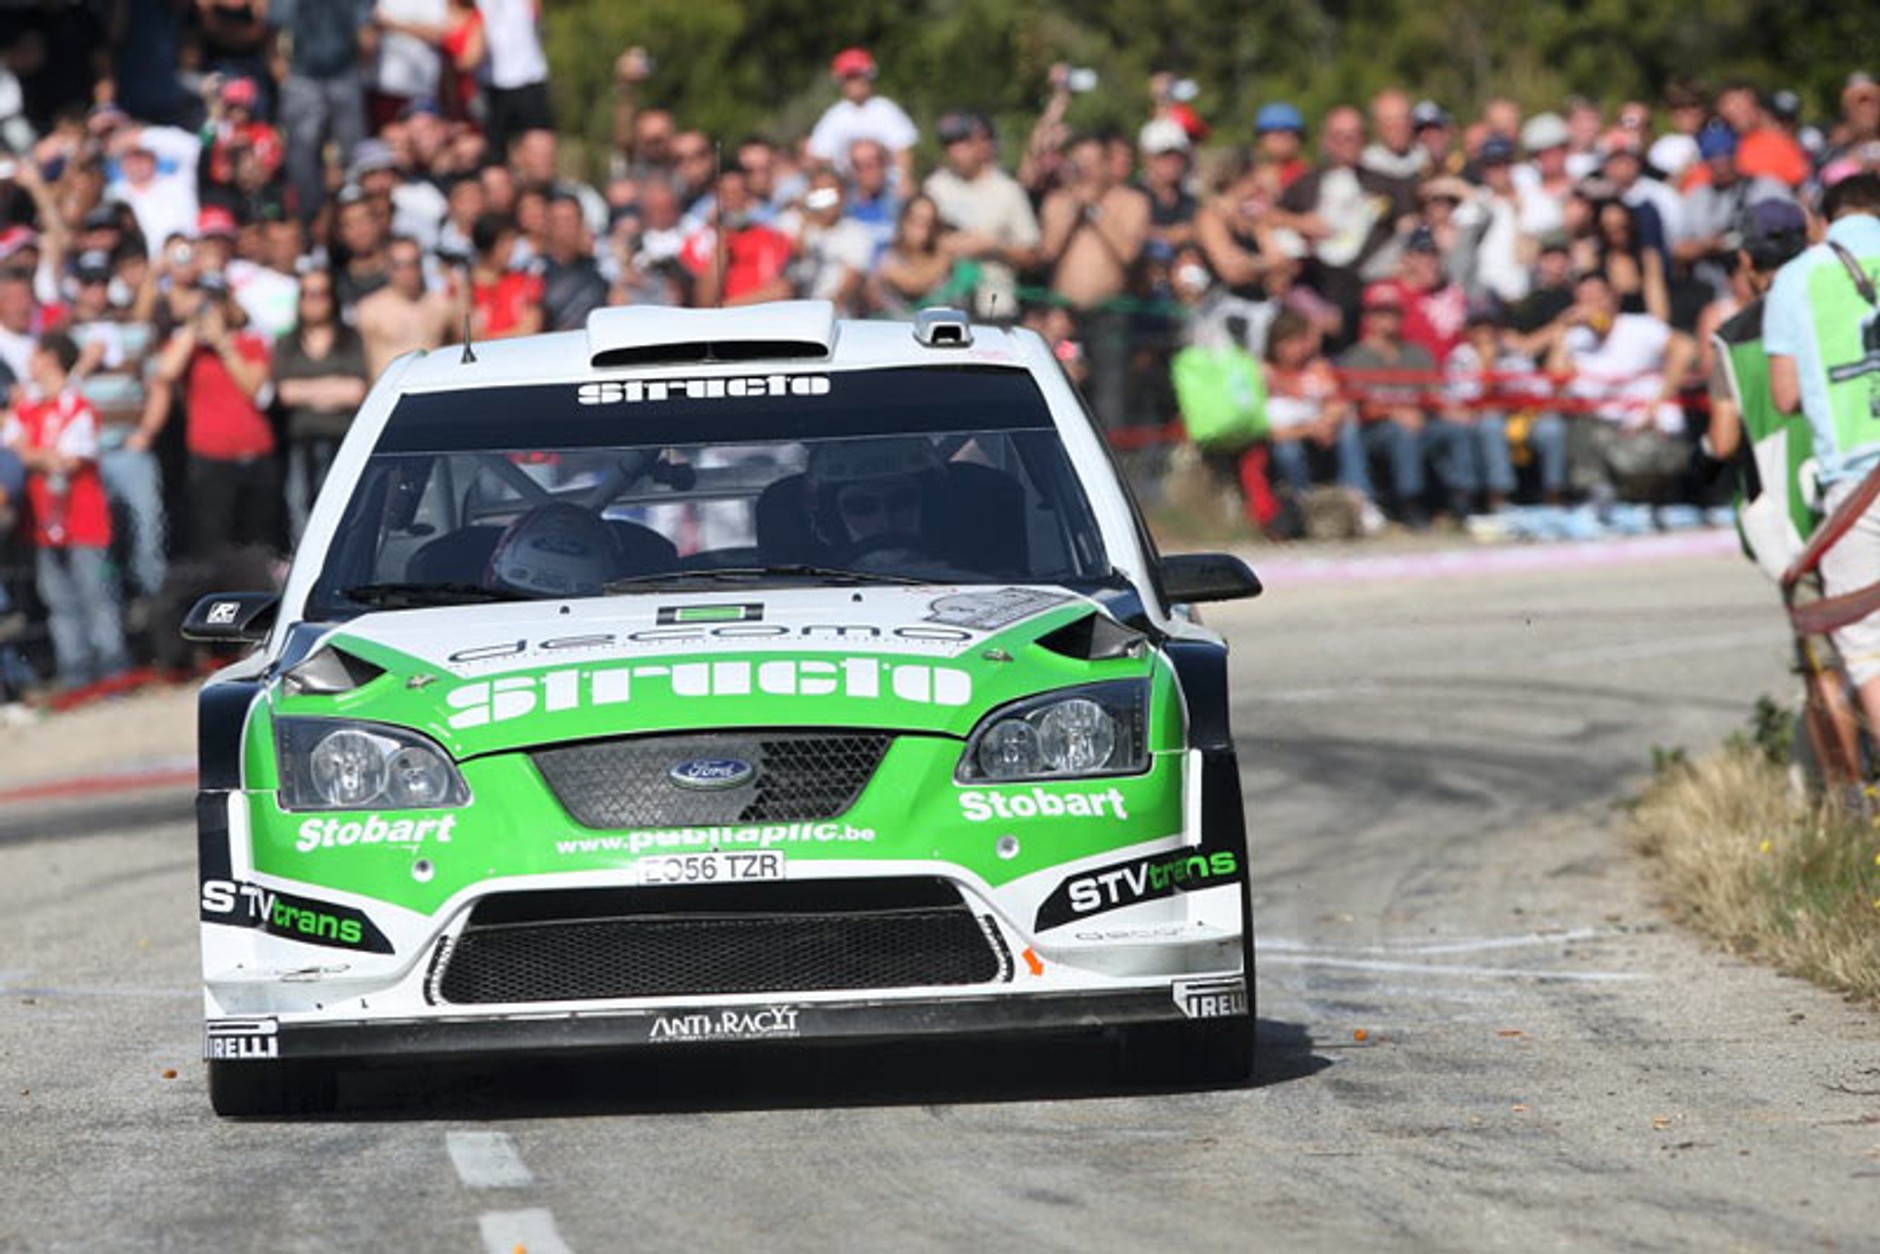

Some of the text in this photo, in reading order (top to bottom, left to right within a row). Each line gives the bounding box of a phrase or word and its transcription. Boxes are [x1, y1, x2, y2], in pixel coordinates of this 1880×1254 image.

[578, 375, 830, 405] structo
[446, 656, 972, 729] structo
[687, 759, 736, 778] Ford
[958, 787, 1128, 822] Stobart
[296, 814, 457, 852] Stobart
[724, 854, 778, 878] TZR
[201, 880, 363, 944] STVtrans
